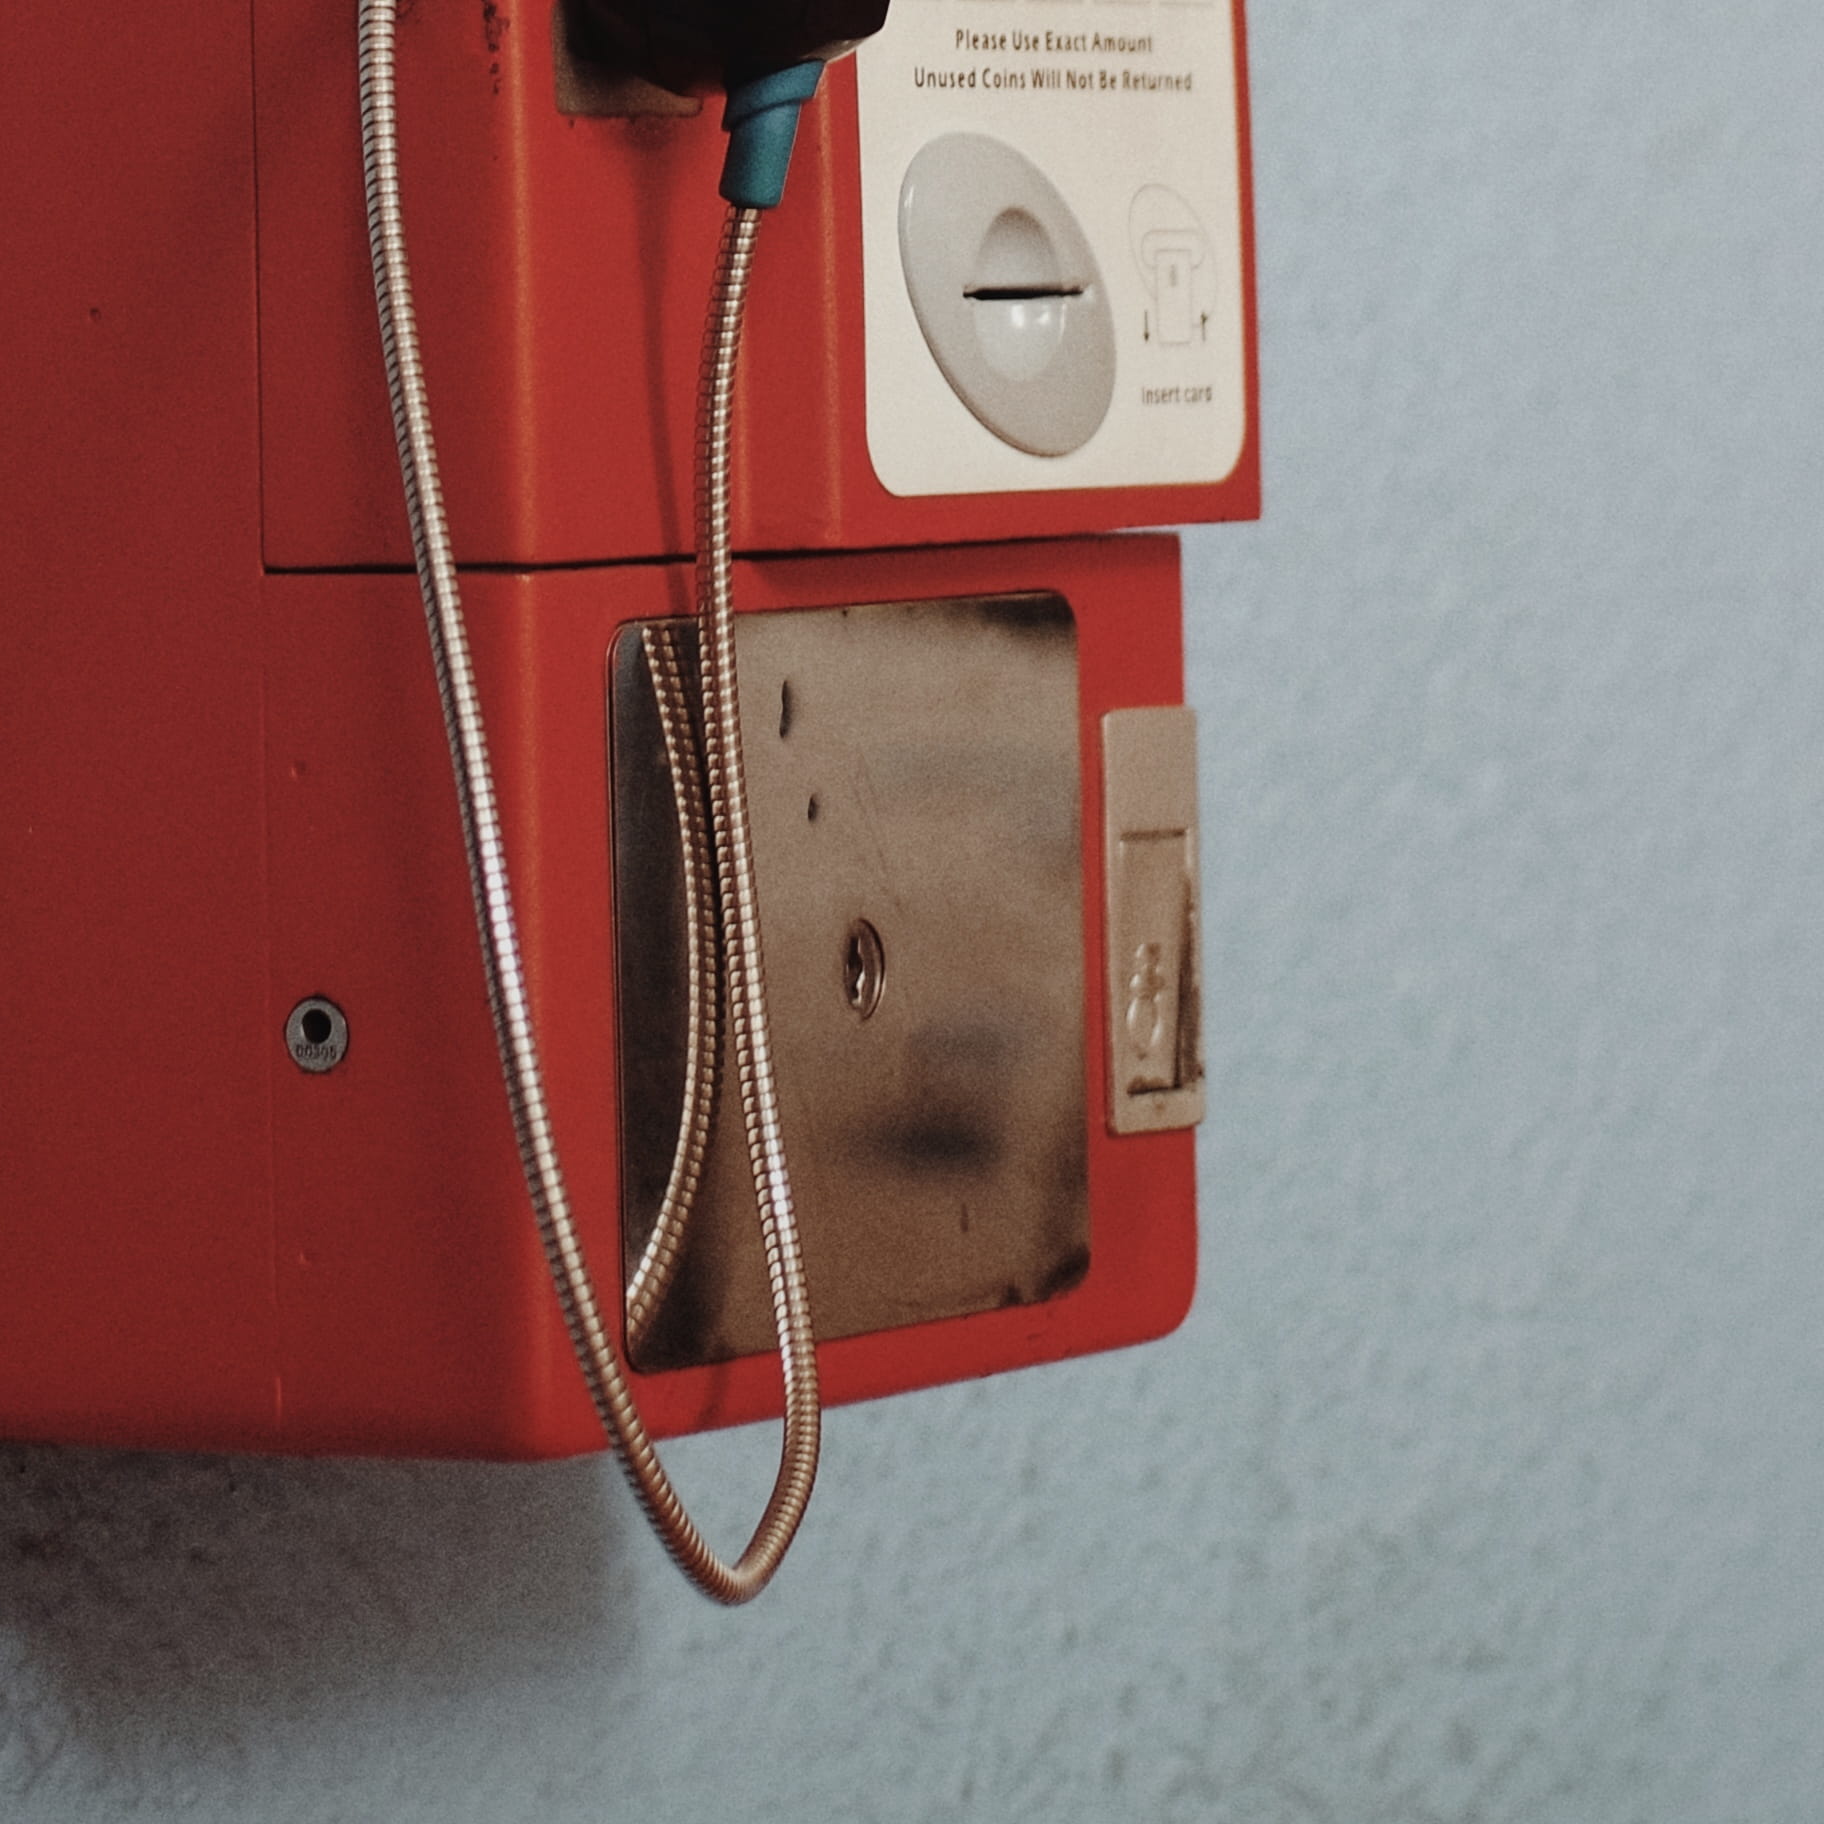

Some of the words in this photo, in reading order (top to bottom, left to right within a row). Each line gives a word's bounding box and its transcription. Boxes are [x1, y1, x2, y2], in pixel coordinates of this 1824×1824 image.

[955, 28, 1007, 52] Please
[1012, 29, 1040, 52] Use
[1045, 30, 1087, 52] Exact
[1091, 31, 1153, 53] Amount
[914, 66, 977, 89] Unused
[981, 67, 1026, 90] Coins
[1031, 69, 1061, 90] Will
[1066, 71, 1094, 91] Not
[1099, 71, 1118, 91] Be
[1122, 71, 1193, 92] Returned
